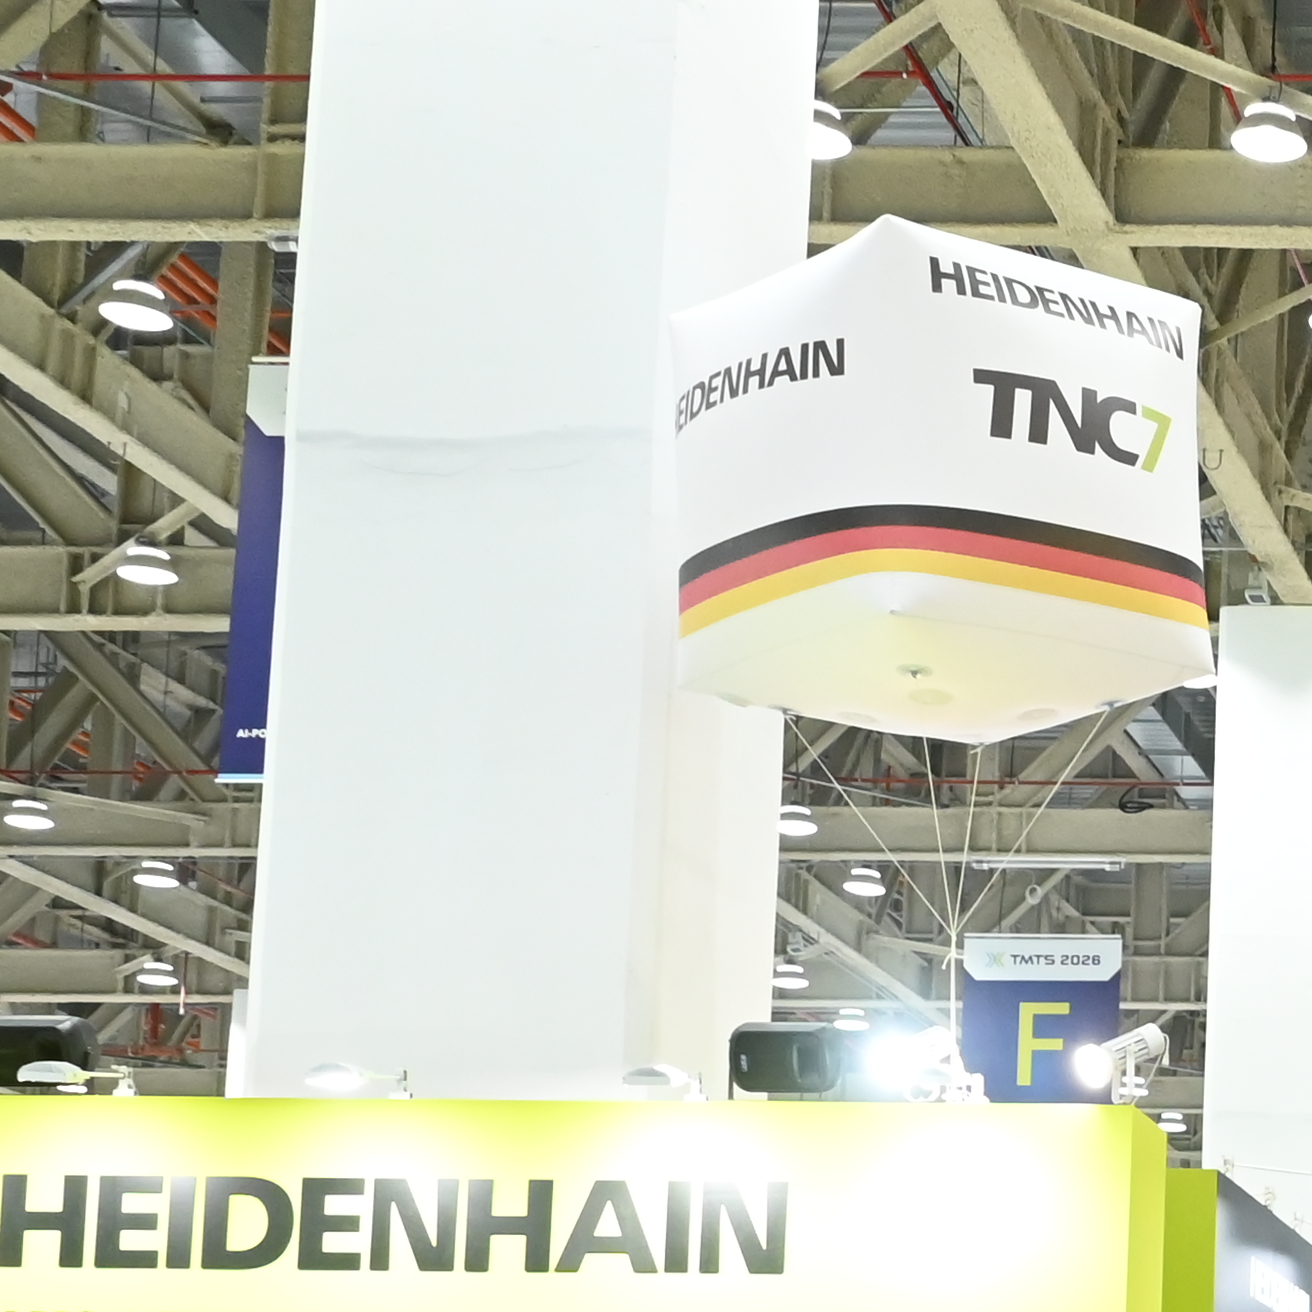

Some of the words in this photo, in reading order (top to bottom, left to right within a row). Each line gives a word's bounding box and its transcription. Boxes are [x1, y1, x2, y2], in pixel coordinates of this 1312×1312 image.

[929, 256, 1184, 360] HEIDENHAIN
[972, 368, 1172, 473] TNC7
[1010, 954, 1056, 966] TMTS
[1060, 954, 1101, 966] 2026
[1016, 1002, 1071, 1086] F
[0, 1174, 789, 1275] HEIDENHAIN
